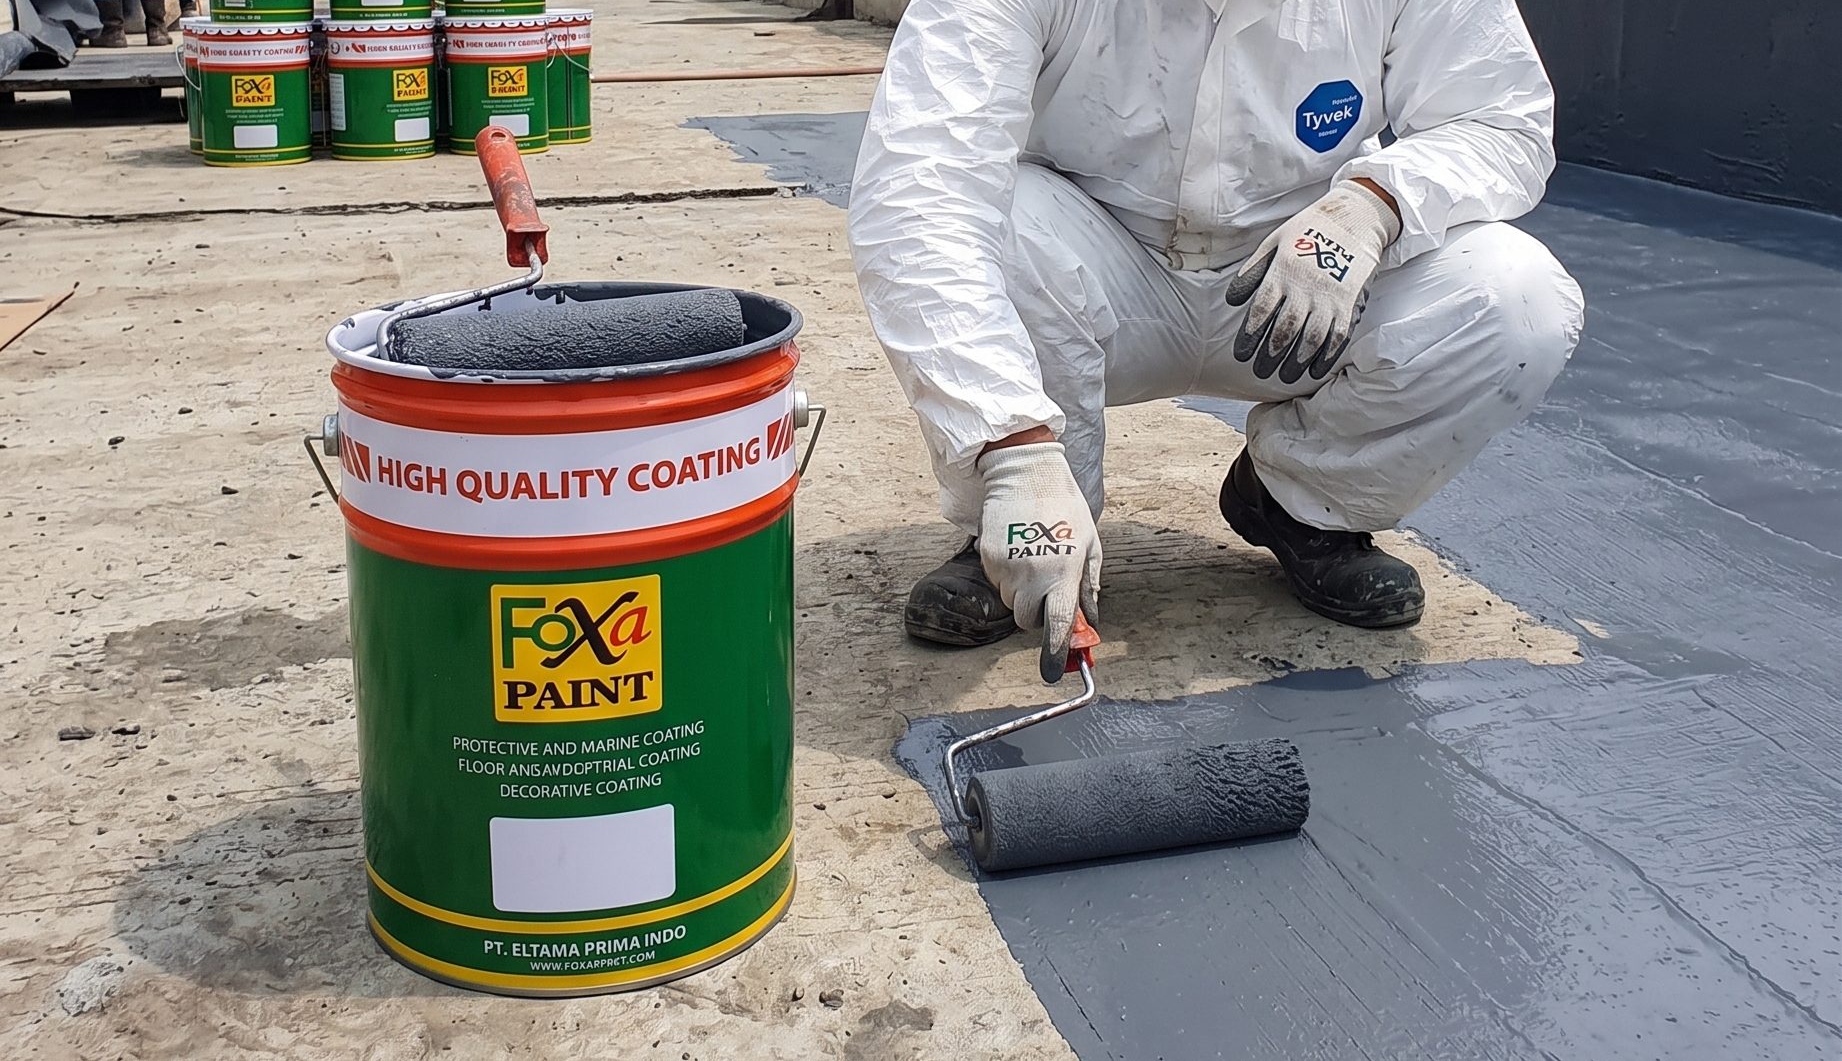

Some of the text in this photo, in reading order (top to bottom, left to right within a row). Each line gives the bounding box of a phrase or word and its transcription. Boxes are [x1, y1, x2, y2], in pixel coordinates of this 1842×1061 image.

[1302, 105, 1353, 130] Tyvek
[378, 436, 761, 503] HIGH QUALITY COATING
[1007, 544, 1077, 560] PAINT
[503, 670, 653, 710] PAINT
[453, 720, 705, 756] PROTECTIVE AND MARINE COATING
[458, 758, 505, 776] FLOOR
[638, 742, 701, 767] COATING
[500, 772, 662, 799] DECORATIVE COATING
[484, 925, 687, 958] PT. ELTAMA PRIMA INDO
